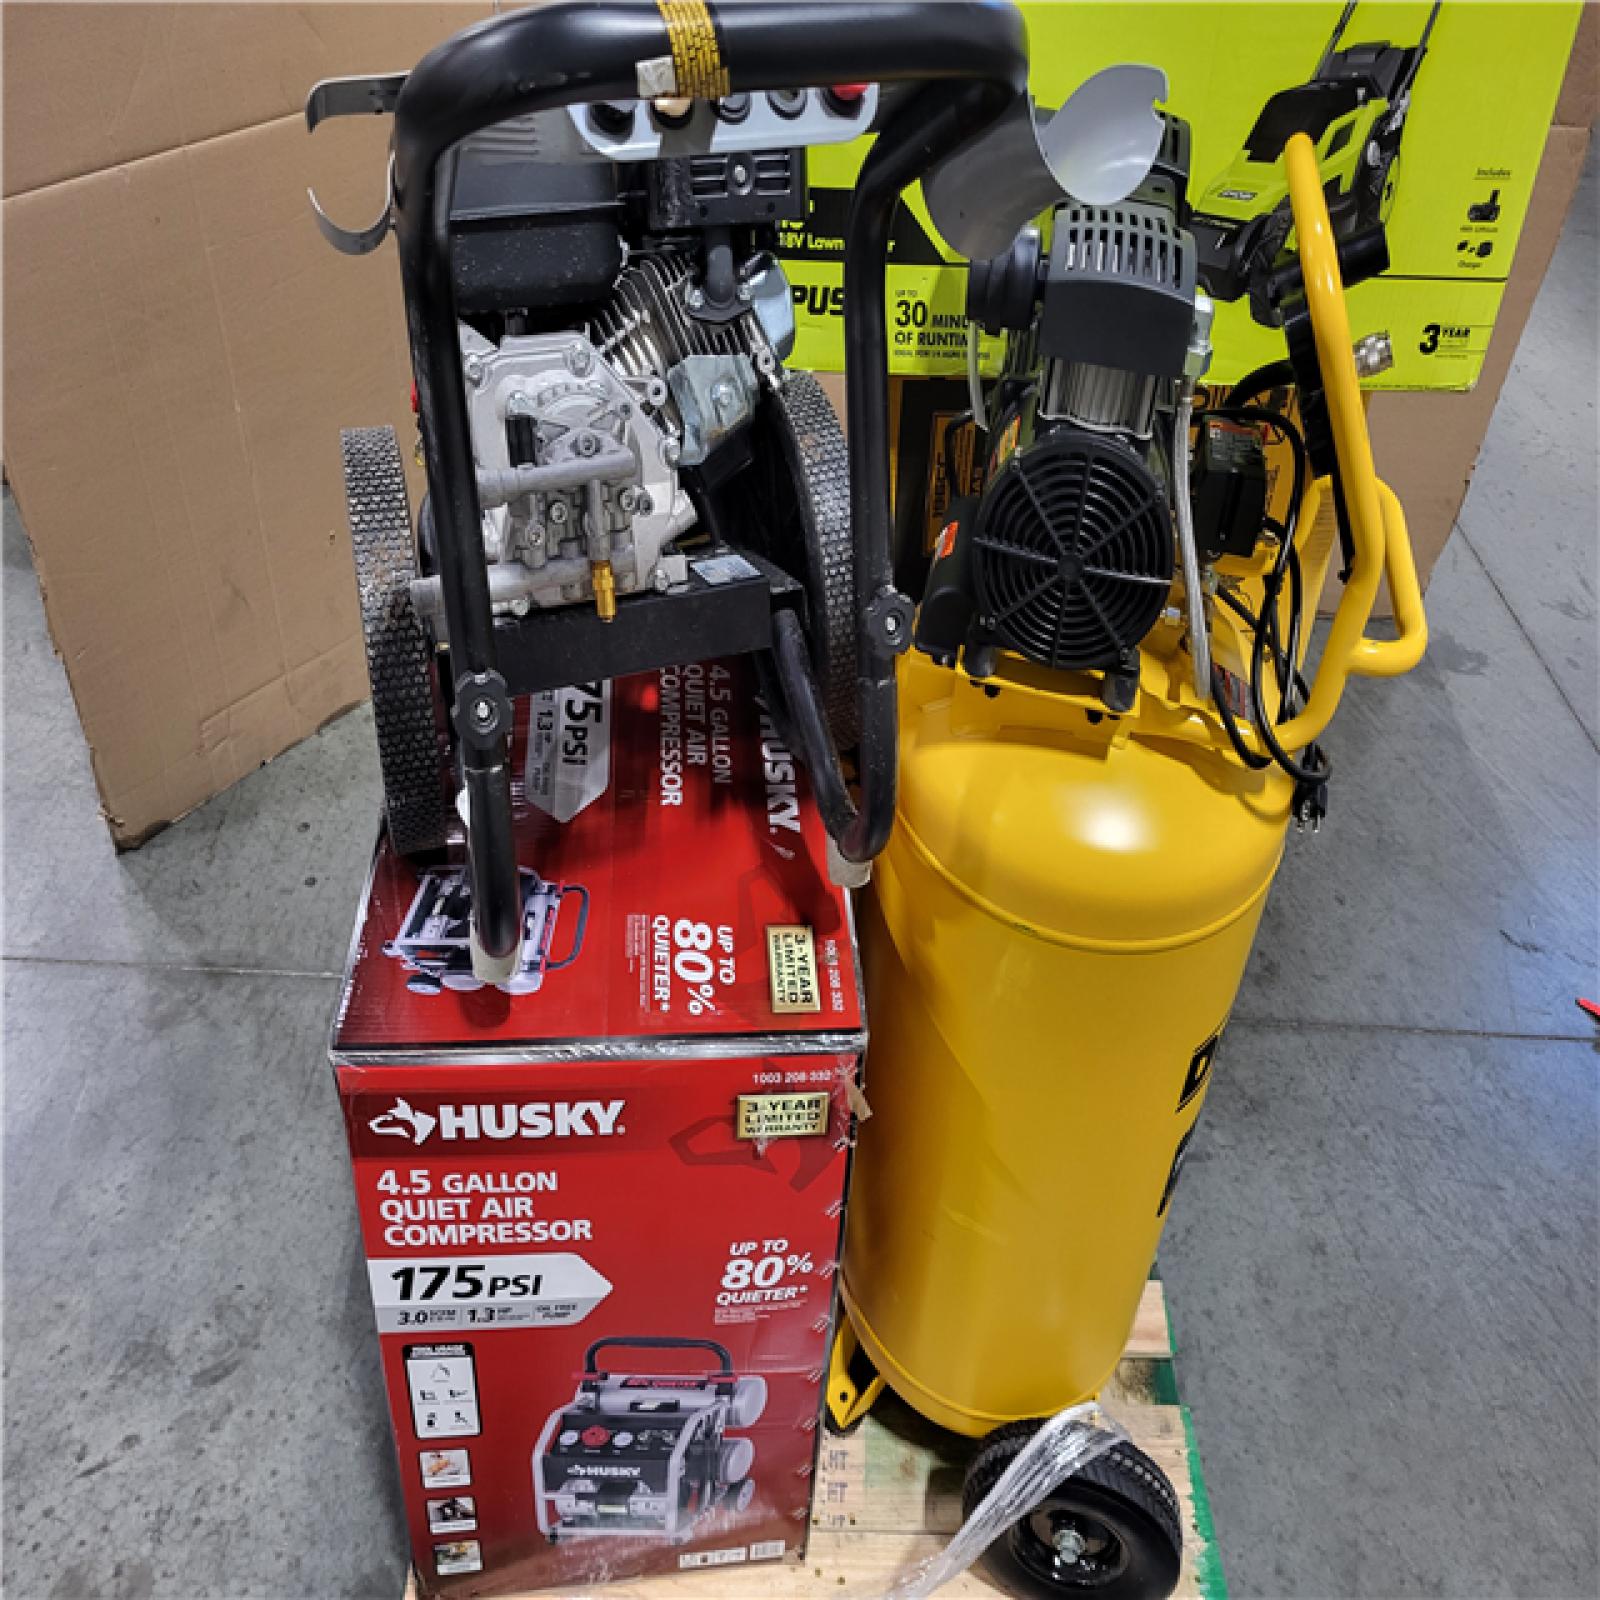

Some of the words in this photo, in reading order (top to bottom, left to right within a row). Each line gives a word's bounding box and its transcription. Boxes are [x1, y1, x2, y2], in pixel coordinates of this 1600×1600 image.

[791, 285, 845, 316] PUS
[895, 300, 928, 328] 30
[895, 332, 912, 346] OF
[1419, 323, 1441, 355] 3
[684, 664, 706, 723] QUIET
[710, 665, 733, 702] 4.5
[564, 682, 603, 723] 75
[659, 665, 684, 807] COMPRESSOR
[686, 729, 709, 766] AIR
[710, 707, 734, 784] GALLON
[717, 925, 734, 954] UP
[674, 918, 721, 1016] 80%
[719, 956, 736, 985] TO
[781, 934, 799, 1004] LIMITED
[437, 1099, 627, 1140] HUSKY
[376, 1169, 432, 1195] 4.5
[442, 1171, 559, 1194] GALLON
[379, 1197, 471, 1223] QUIET
[480, 1196, 534, 1219] AIR
[383, 1219, 593, 1247] COMPRESSOR
[729, 1241, 758, 1256] UP
[762, 1238, 789, 1253] TO
[721, 1251, 814, 1290] 80%
[397, 1309, 429, 1326] 3.0
[466, 1306, 496, 1323] 1.3
